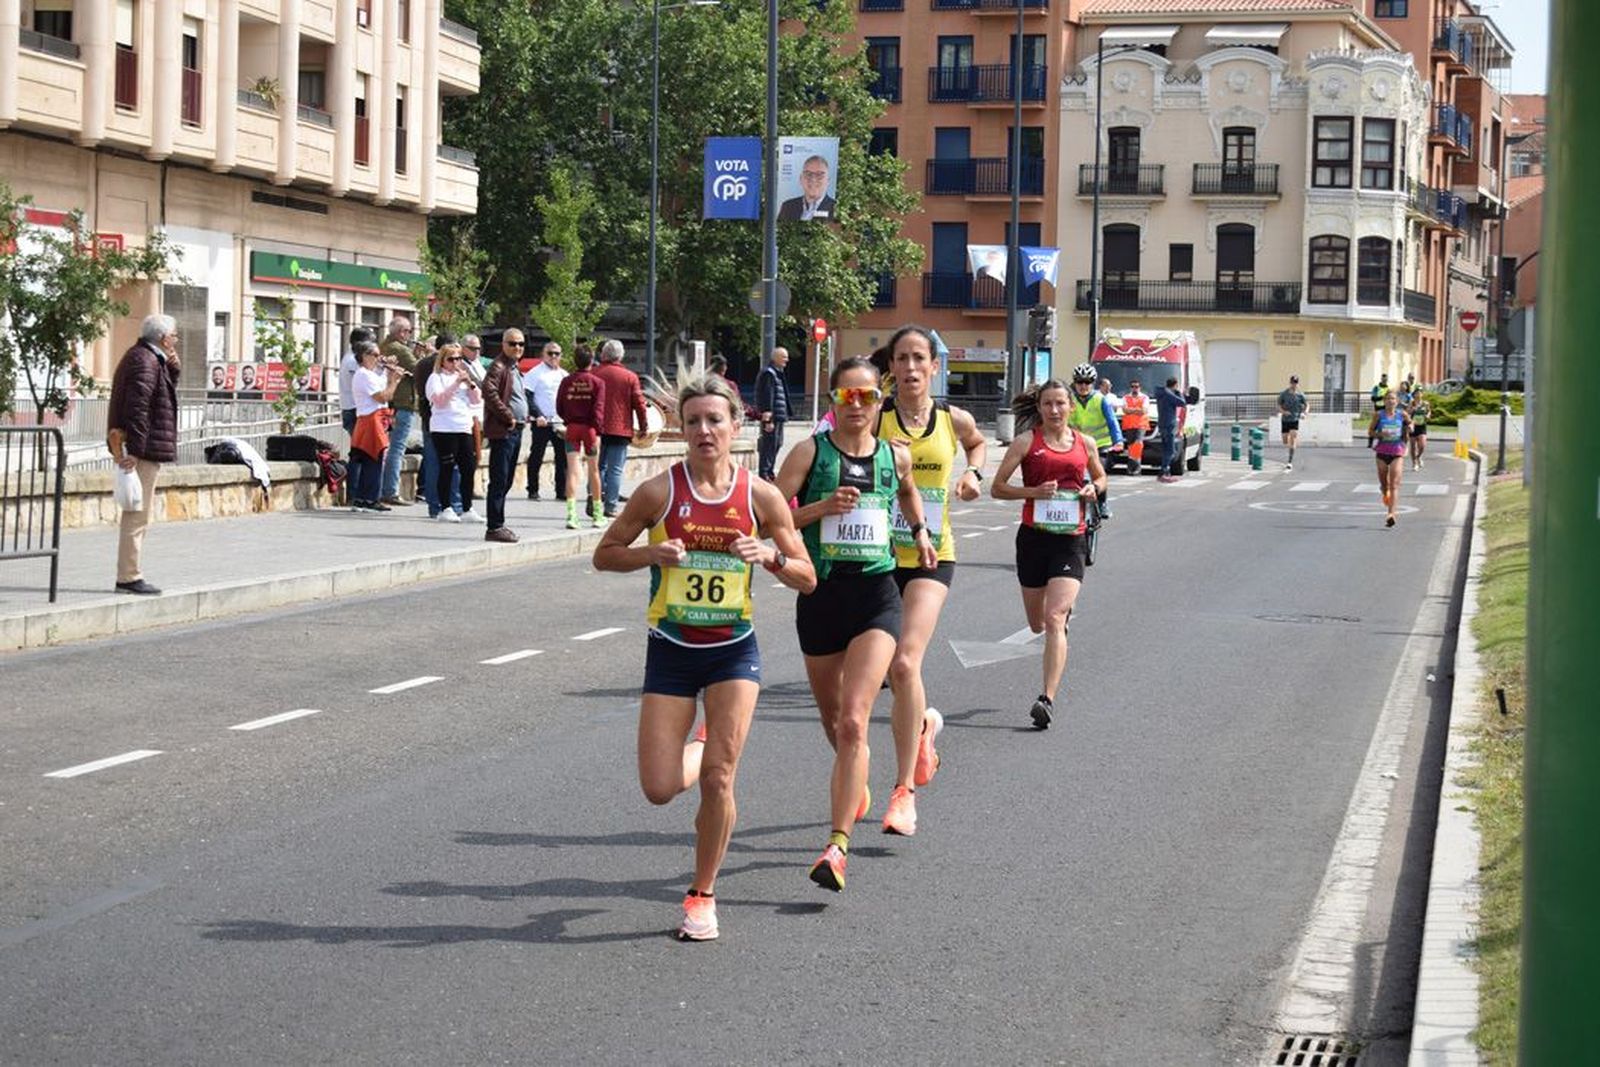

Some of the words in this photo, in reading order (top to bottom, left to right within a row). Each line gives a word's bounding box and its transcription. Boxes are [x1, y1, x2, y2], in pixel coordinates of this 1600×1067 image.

[715, 160, 749, 171] VOTA
[836, 524, 875, 540] MARTA
[693, 534, 723, 543] VINO
[686, 574, 725, 604] 36
[688, 611, 709, 620] CAJA
